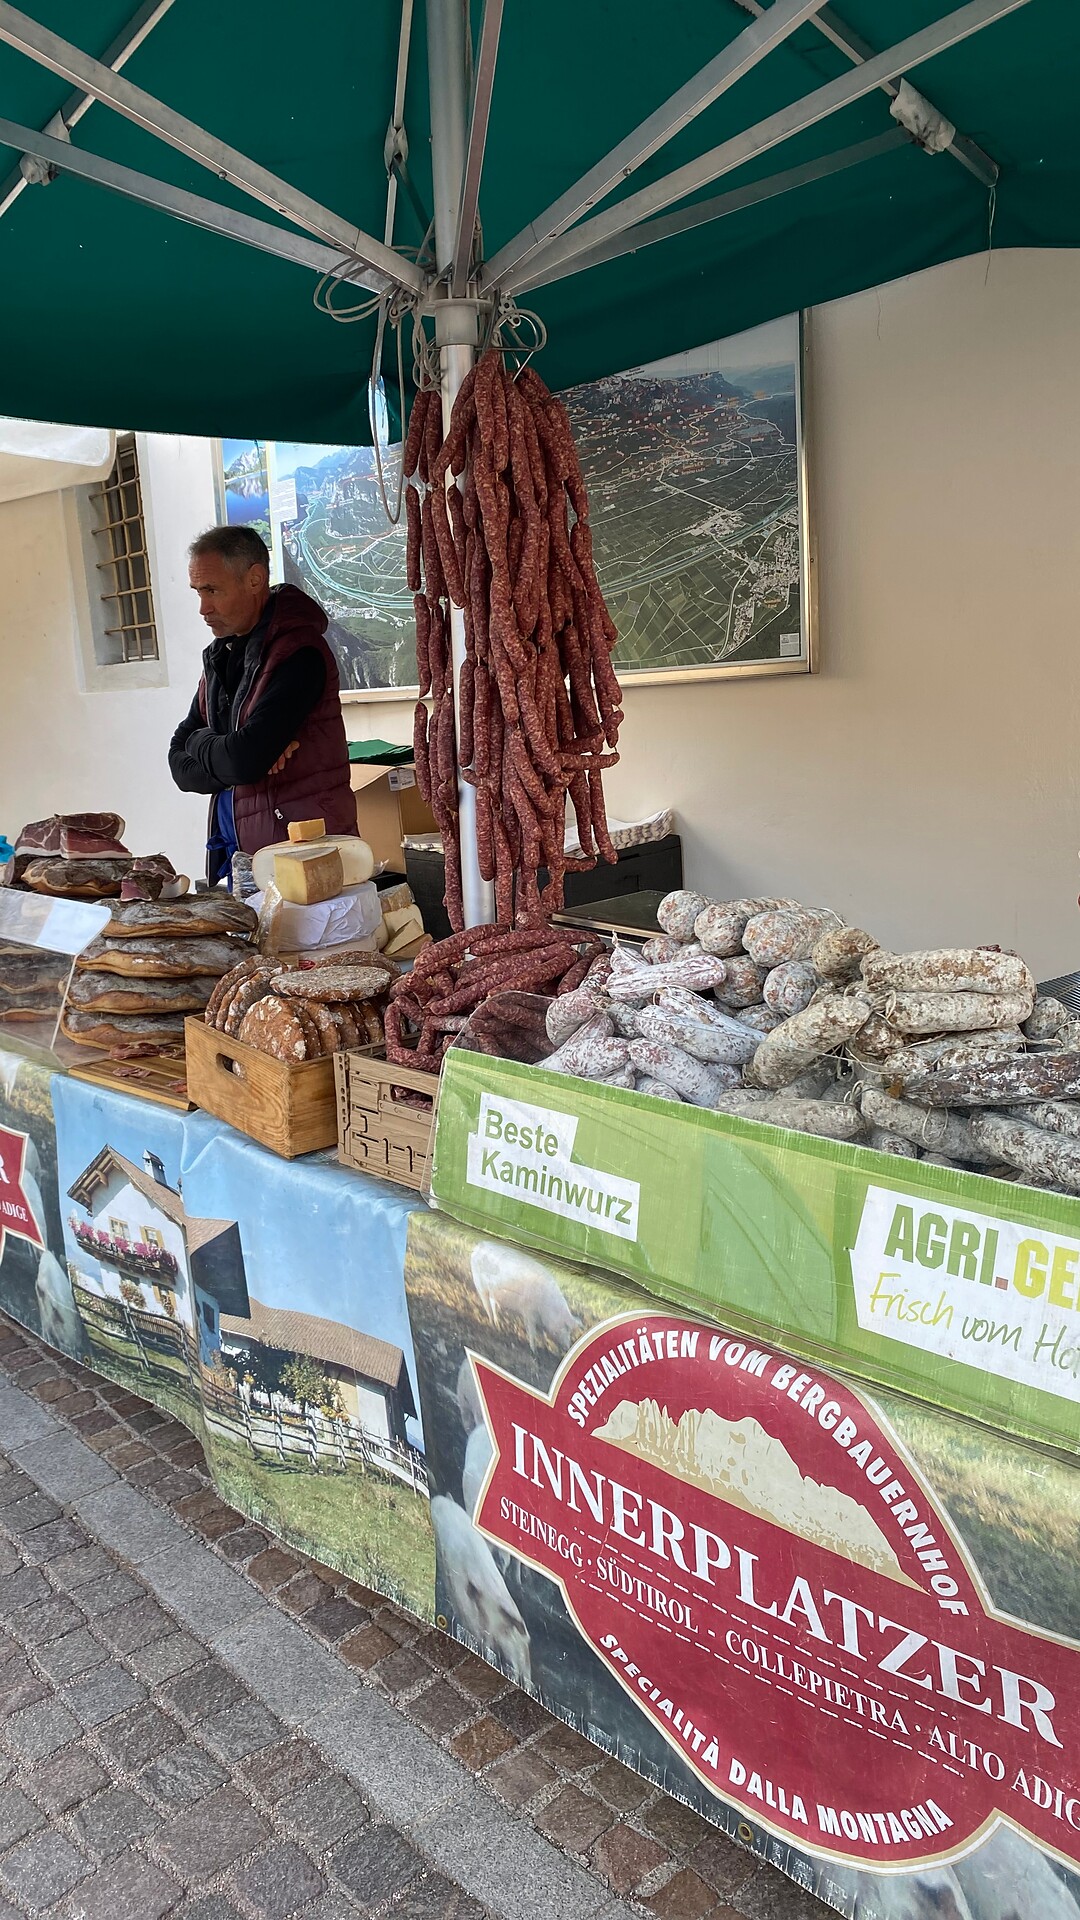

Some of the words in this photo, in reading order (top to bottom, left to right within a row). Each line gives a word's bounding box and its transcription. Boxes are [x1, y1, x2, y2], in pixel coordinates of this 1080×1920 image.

[481, 1147, 633, 1225] Kaminwurz
[485, 1108, 559, 1157] Beste
[2, 1201, 29, 1222] ADIGE
[884, 1203, 1080, 1313] AGRI.GE
[869, 1271, 955, 1330] Frisch
[961, 1315, 1023, 1352] vom
[567, 1328, 700, 1428] SPEZIALITÄTEN
[708, 1335, 773, 1379] VOM
[770, 1363, 971, 1617] BERGBAUERNHOF
[500, 1496, 584, 1568] STEINEGG
[596, 1555, 699, 1634] SÜDTIROL
[725, 1629, 911, 1736] COLLEPIETRA
[928, 1725, 1006, 1781] ALTO
[511, 1422, 1064, 1749] INNERPLATZER
[599, 1633, 721, 1770] SPECIALITÀ
[729, 1757, 809, 1826] DALLA
[816, 1798, 955, 1845] MONTAGNA
